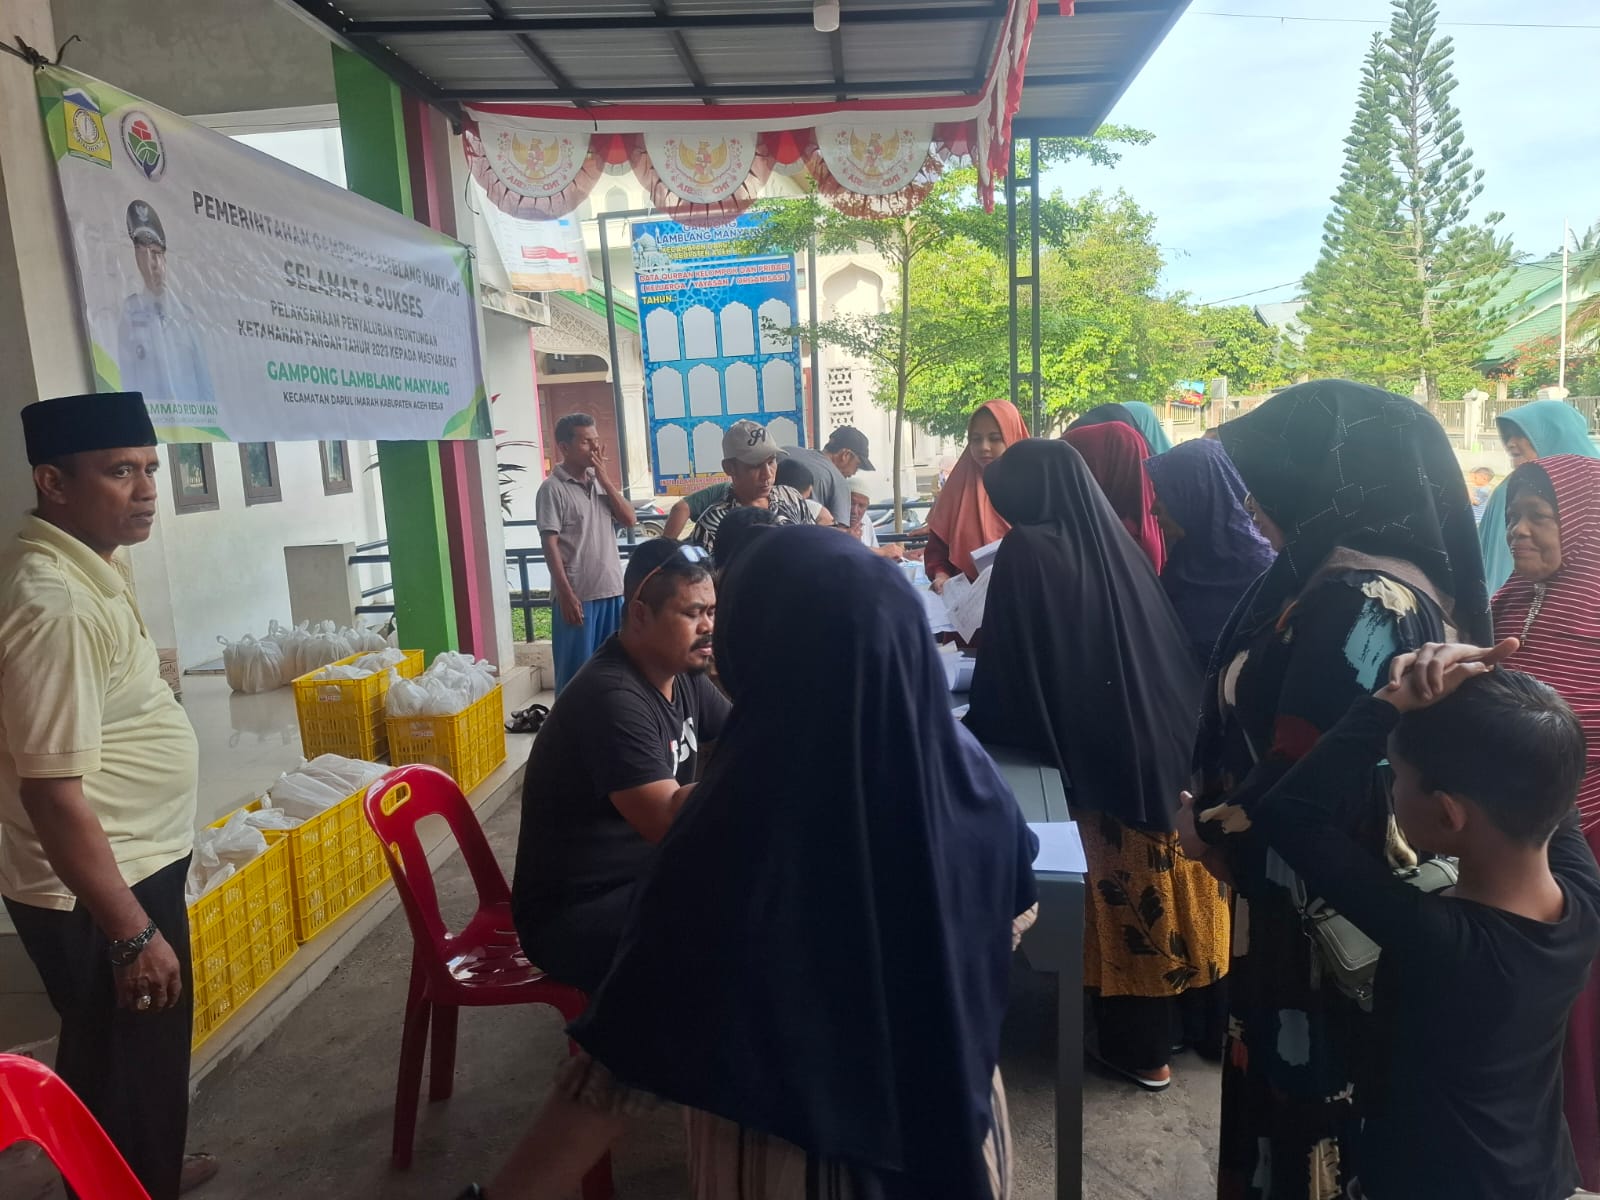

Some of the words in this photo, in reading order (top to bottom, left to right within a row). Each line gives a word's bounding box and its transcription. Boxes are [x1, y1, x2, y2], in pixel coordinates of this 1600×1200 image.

[192, 190, 311, 249] PEMERINTAHAN
[656, 230, 712, 245] LAMBLANG
[639, 273, 661, 283] DATA
[661, 270, 694, 281] QURBAN
[695, 266, 738, 279] KELOMPOK
[739, 264, 758, 275] DAN
[758, 262, 791, 273] PRIBADI
[693, 278, 729, 289] YAYASAN
[283, 260, 359, 303] SELAMAT
[375, 286, 425, 319] SUKSES
[641, 294, 673, 305] TAHUN
[270, 299, 341, 330] PELAKSANAAN
[341, 315, 394, 340] PENYALURAN
[394, 327, 438, 347] KEUNTUNGAN
[237, 319, 304, 345] KETAHANAN
[304, 331, 342, 352] PANGAN
[343, 337, 371, 355] TAHUN
[390, 344, 418, 362] KEPADA
[417, 350, 458, 368] MASYARAKAT
[267, 360, 339, 387] GAMPONG
[340, 368, 403, 392] LAMBLANG
[403, 376, 451, 396] MANYANG
[283, 391, 331, 406] KECAMATAN
[331, 394, 354, 407] DARUL
[354, 395, 379, 408] IMARAH
[380, 397, 412, 409] KABUPATEN
[413, 400, 427, 410] ACEH
